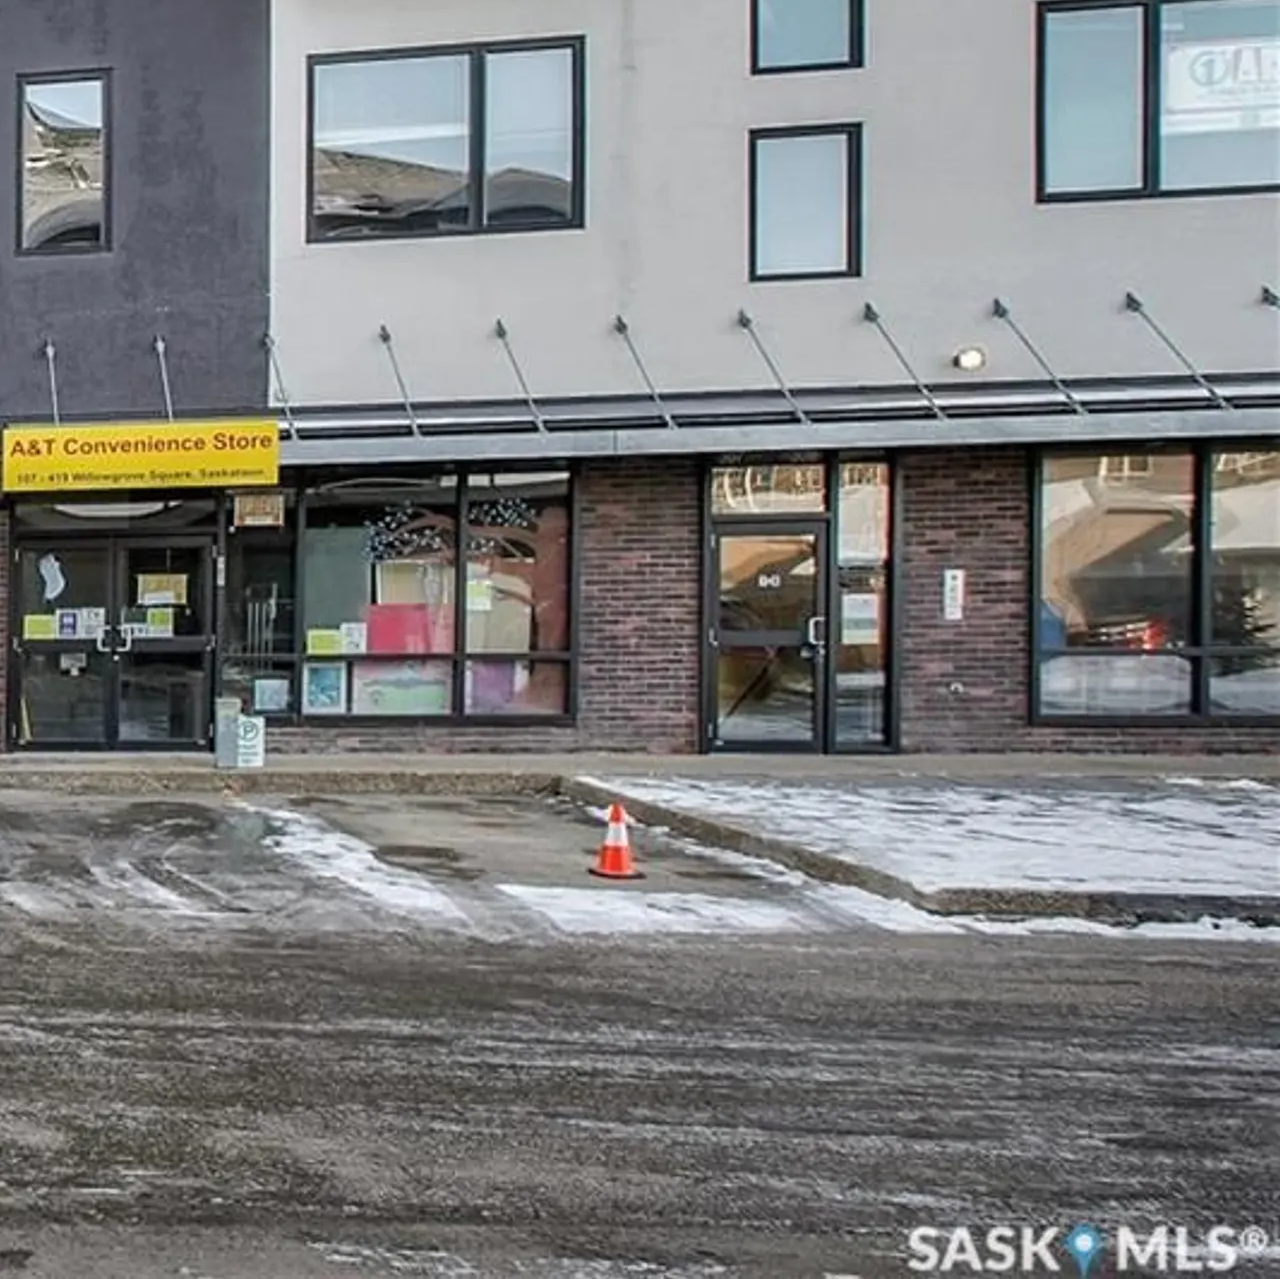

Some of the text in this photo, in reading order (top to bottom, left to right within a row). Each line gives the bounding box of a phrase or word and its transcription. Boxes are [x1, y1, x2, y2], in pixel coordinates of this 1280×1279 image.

[10, 430, 273, 458] A&T Convenience Store
